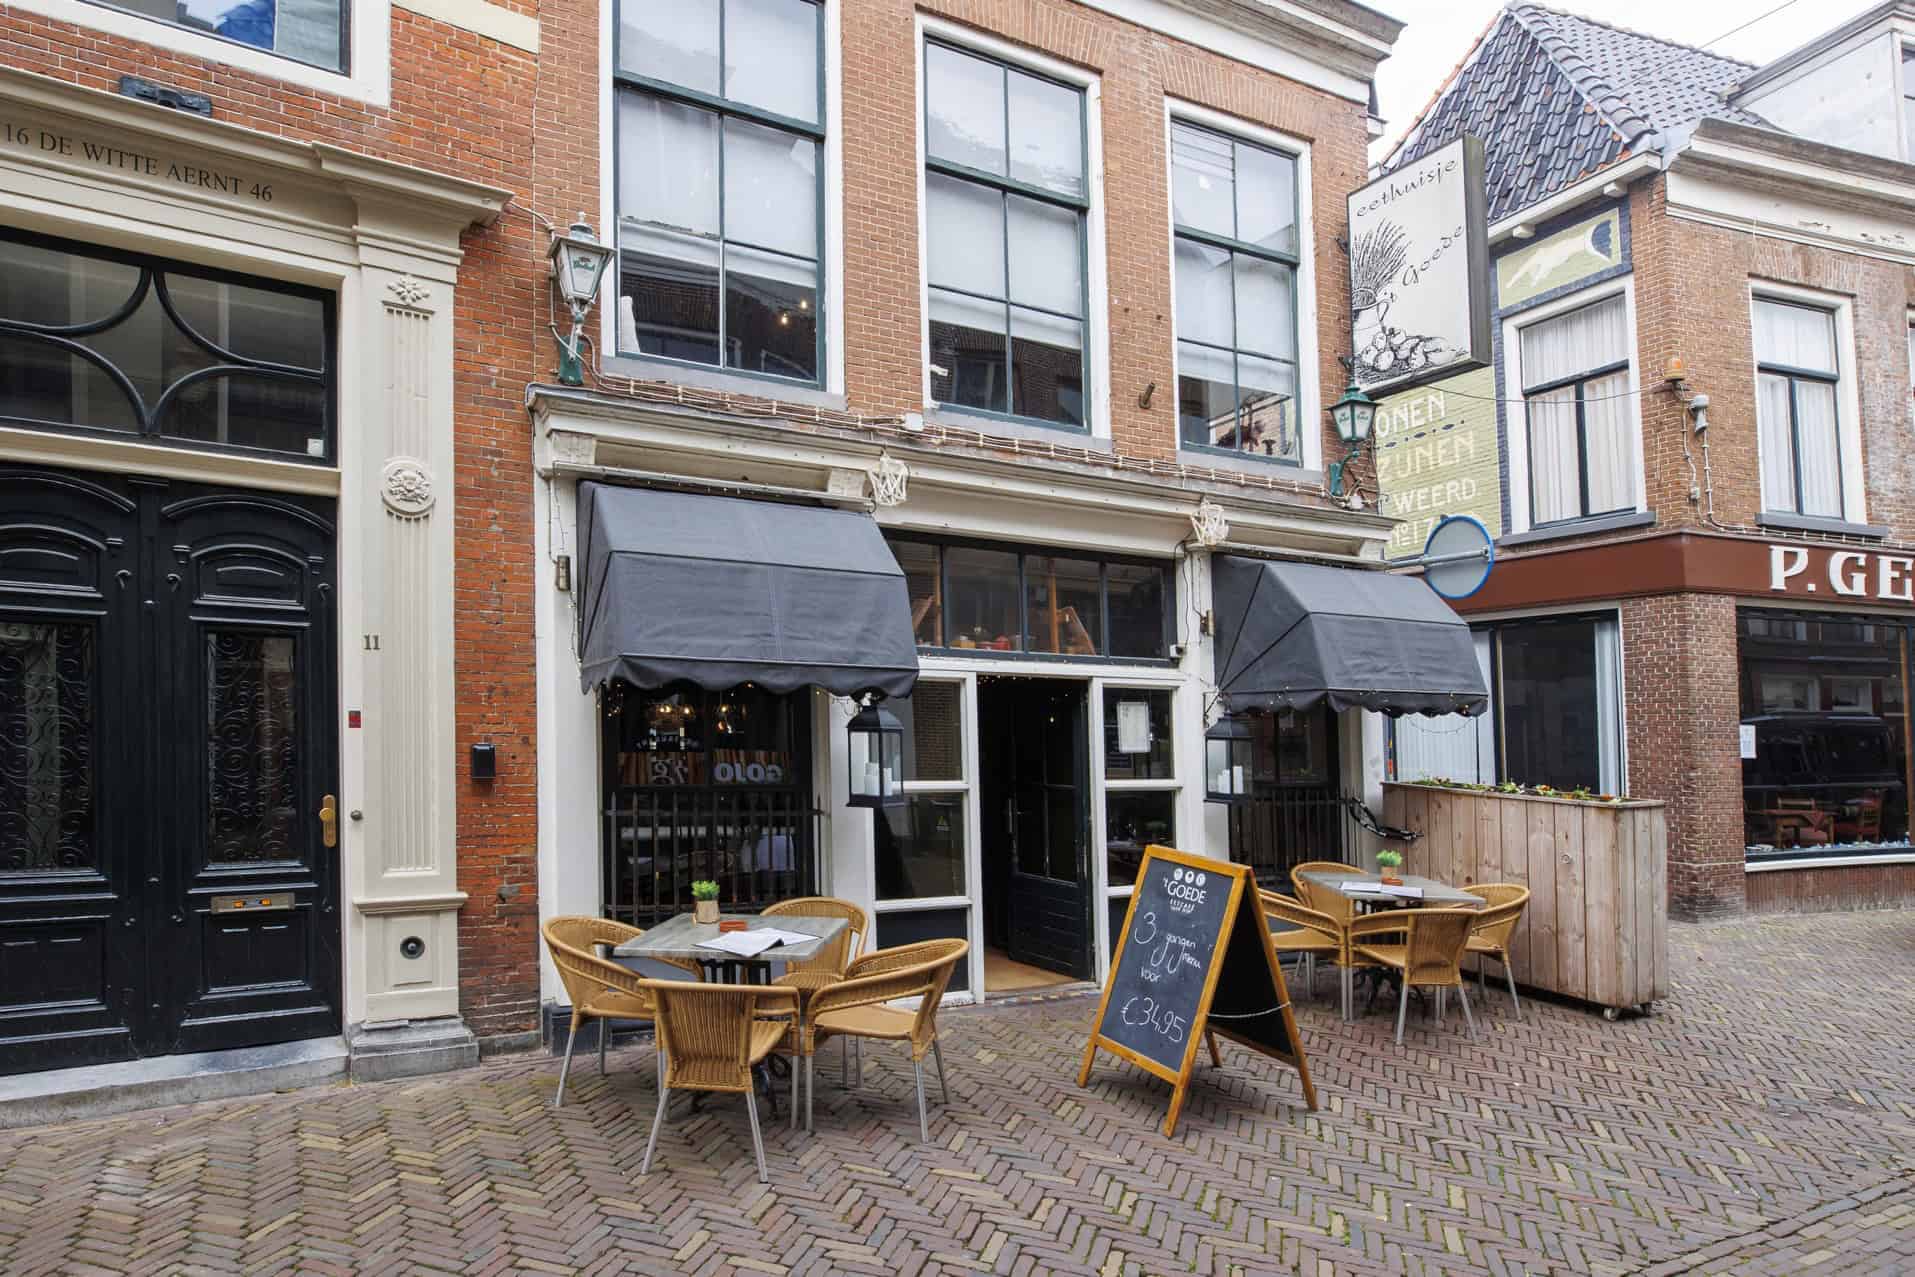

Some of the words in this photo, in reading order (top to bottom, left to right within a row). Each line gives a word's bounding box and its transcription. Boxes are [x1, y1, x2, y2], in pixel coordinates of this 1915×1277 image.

[7, 124, 30, 145] 16
[39, 130, 73, 157] DE
[82, 142, 159, 175] WITTE
[166, 163, 241, 195] AERNT
[249, 183, 274, 203] 46
[363, 634, 381, 650] 11
[1167, 881, 1207, 904] GOEDE
[1134, 911, 1157, 945] 3
[1150, 933, 1197, 974] gangen
